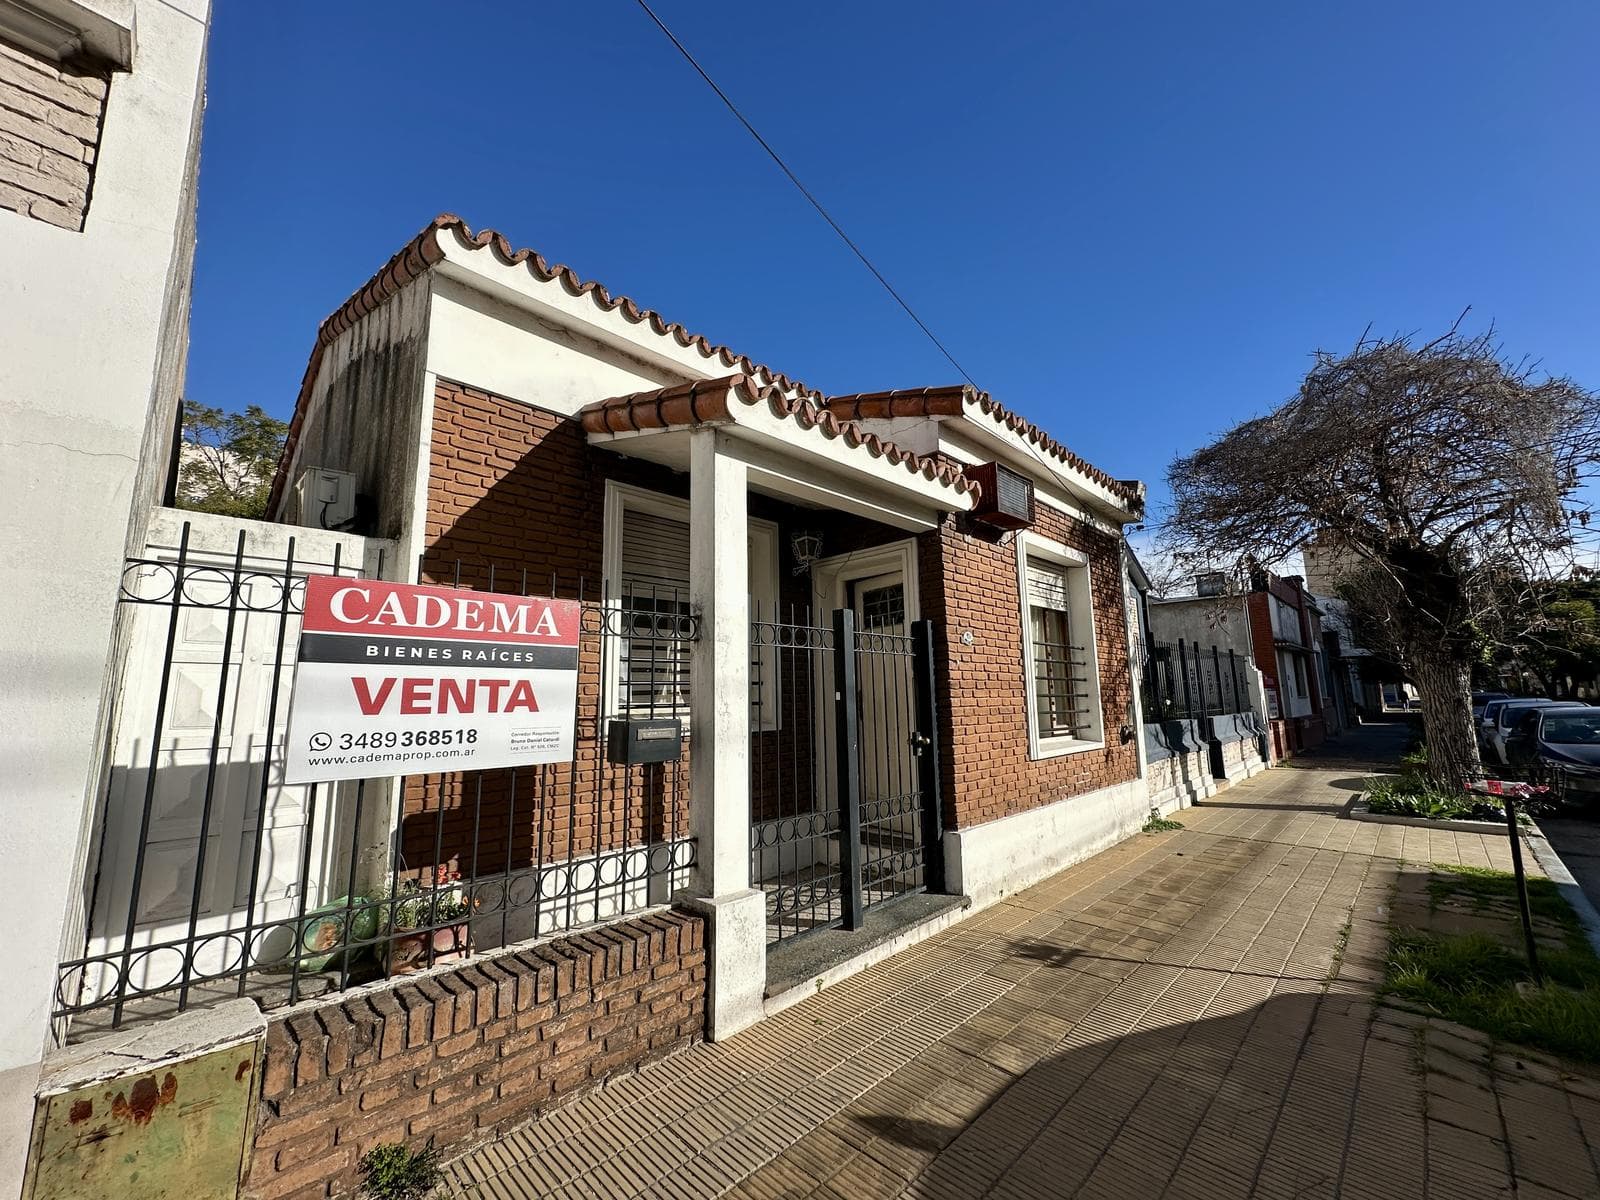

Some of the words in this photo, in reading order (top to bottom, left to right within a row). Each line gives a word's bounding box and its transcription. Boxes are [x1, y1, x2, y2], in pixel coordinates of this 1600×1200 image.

[329, 587, 561, 637] CADEMA
[366, 645, 452, 659] BIENES
[462, 648, 534, 662] RAÍCES
[351, 677, 540, 716] VENTA
[308, 748, 476, 766] www.cademaprop.com.ar
